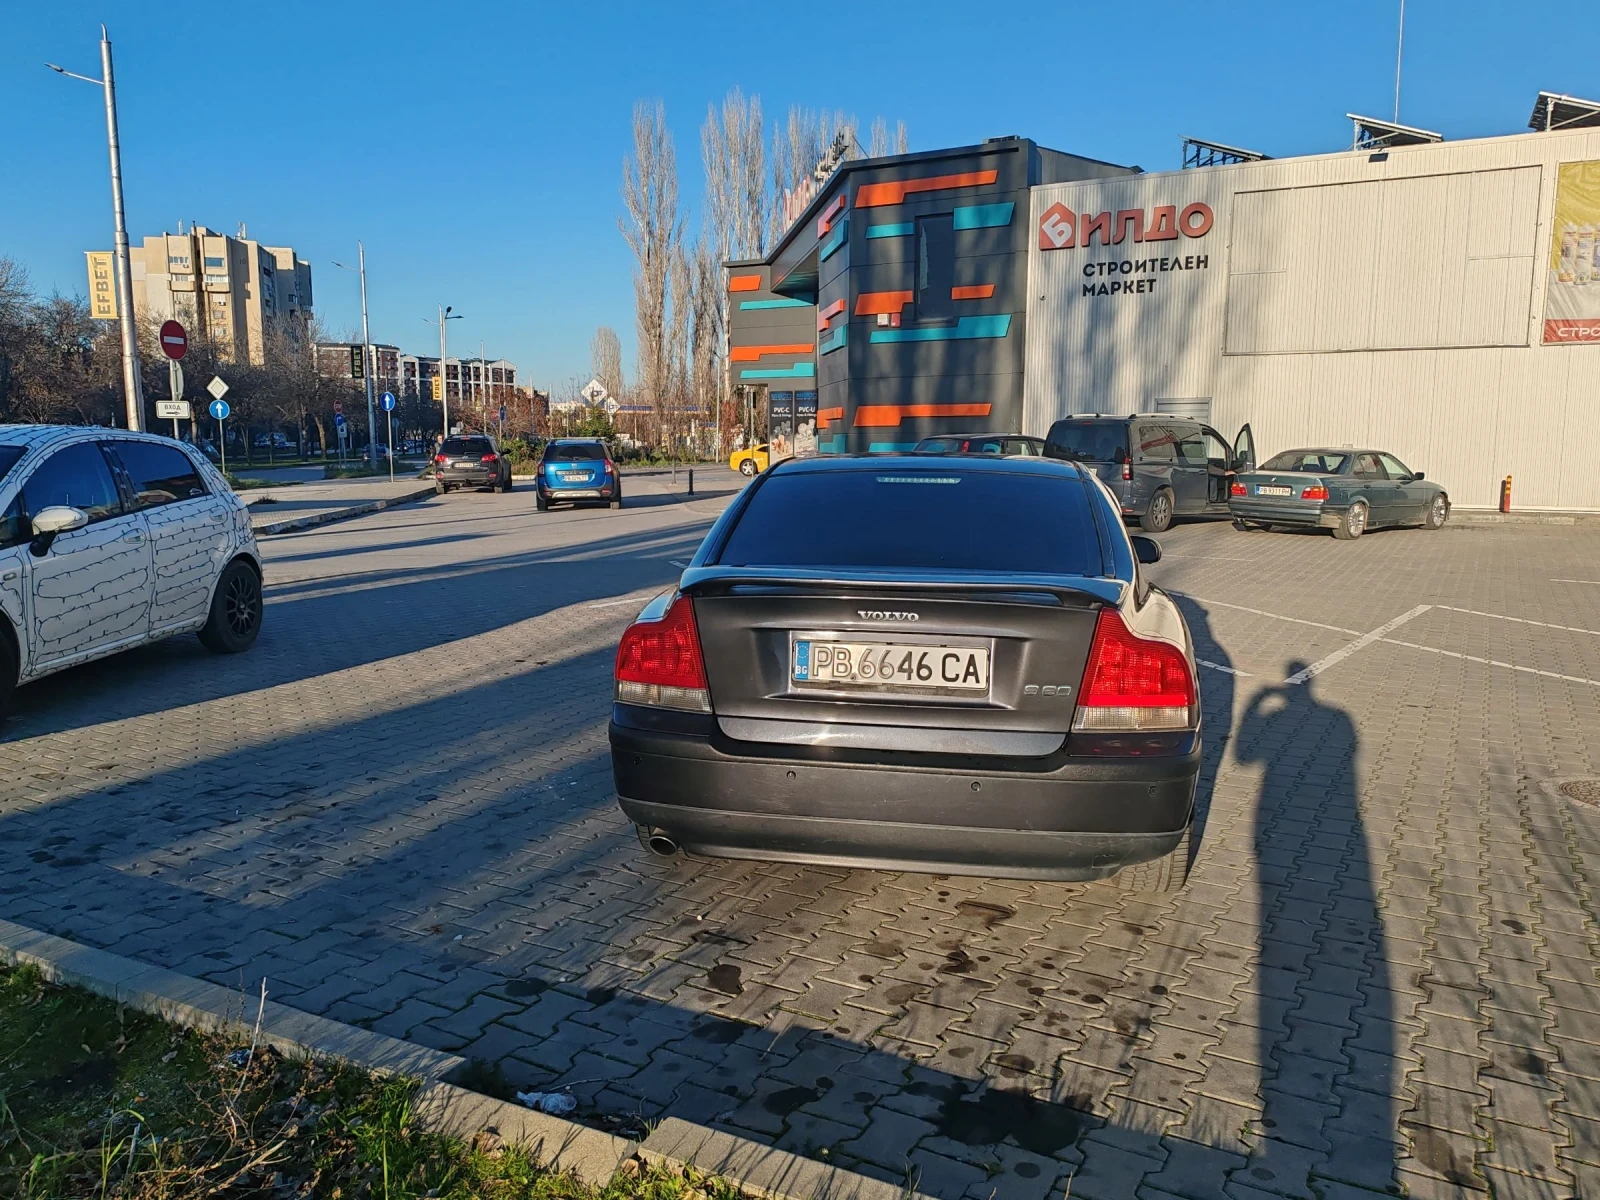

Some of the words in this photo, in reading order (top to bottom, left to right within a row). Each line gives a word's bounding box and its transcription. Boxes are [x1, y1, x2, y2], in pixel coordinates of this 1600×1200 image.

[1040, 202, 1214, 249] БИЛДО
[1082, 254, 1209, 278] СТРОИТЕЛЕН
[93, 256, 111, 315] EFBET
[1082, 278, 1157, 298] МАРКЕТ
[353, 347, 362, 377] EFBET
[857, 610, 919, 621] VOLVO
[796, 665, 808, 675] BG
[812, 646, 853, 678] PB
[857, 648, 933, 682] 6646
[941, 652, 980, 684] CA
